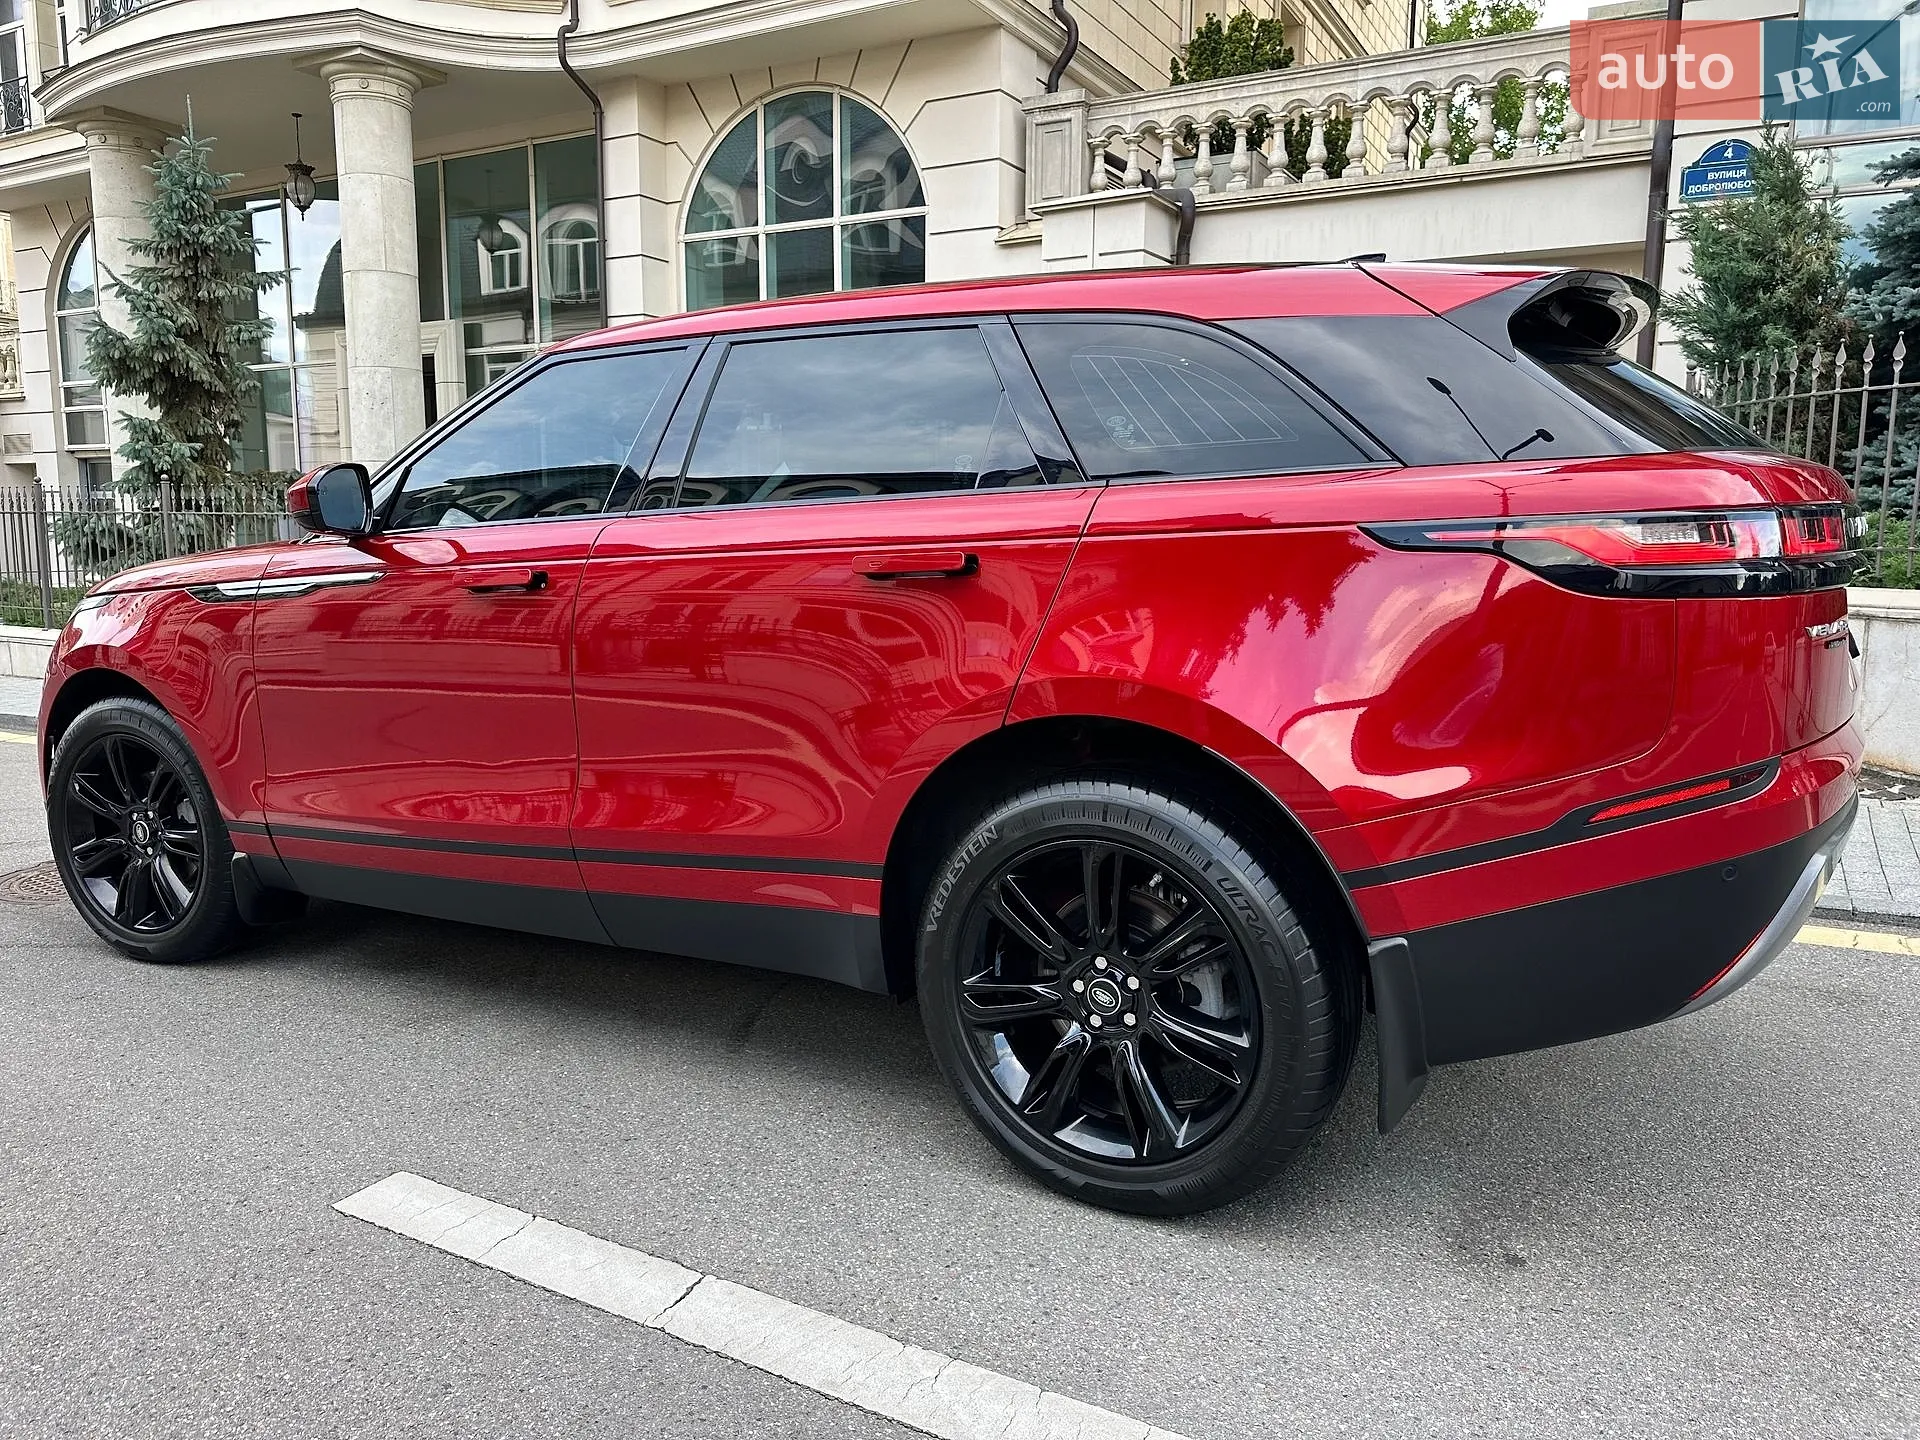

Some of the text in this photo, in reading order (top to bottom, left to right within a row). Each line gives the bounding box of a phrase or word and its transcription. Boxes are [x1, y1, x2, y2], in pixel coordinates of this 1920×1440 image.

[1707, 168, 1747, 180] ВУЛИЦЯ
[1723, 146, 1734, 159] 4
[926, 824, 999, 932] VREDESTEIN
[1216, 877, 1279, 957] ULTRAC
